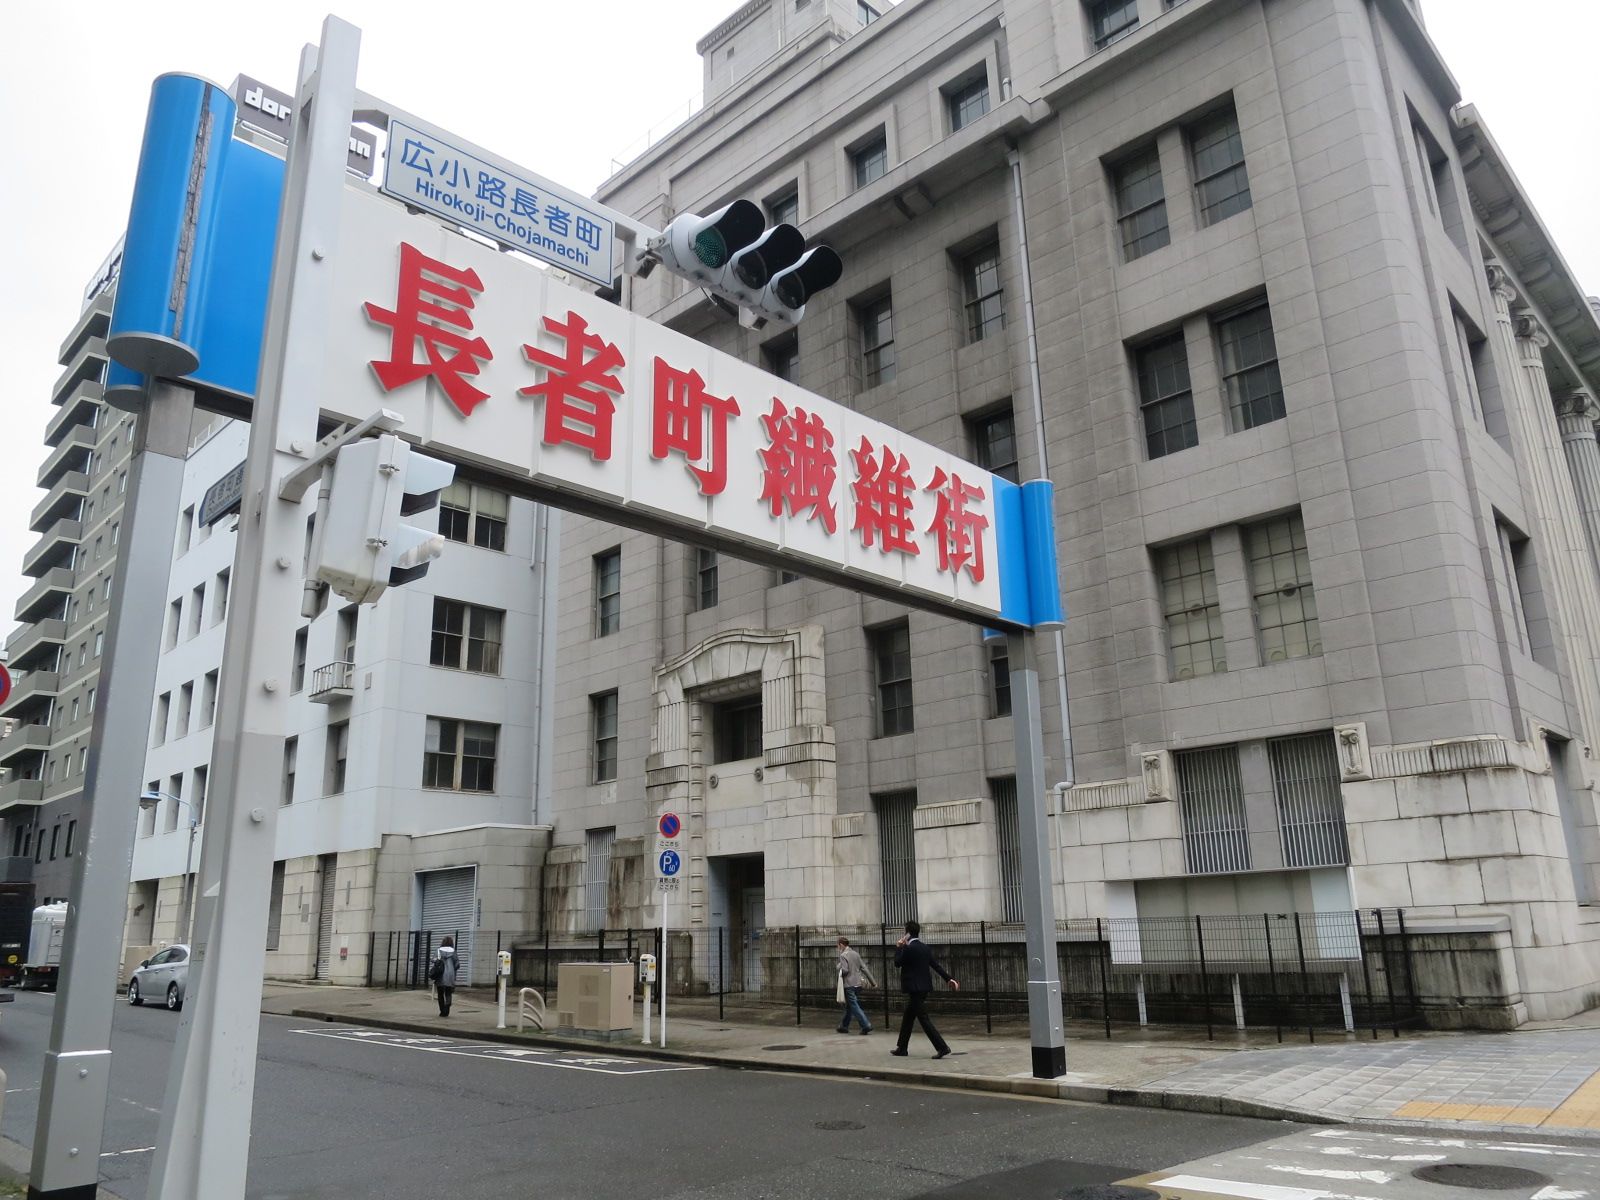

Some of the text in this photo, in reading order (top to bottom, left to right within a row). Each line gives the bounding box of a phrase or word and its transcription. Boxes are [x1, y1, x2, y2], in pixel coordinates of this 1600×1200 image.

[401, 138, 602, 251] 広小路長者町
[416, 177, 589, 266] Hirokoji-Chojamachi
[367, 244, 987, 581] 長者町繊維街
[663, 855, 672, 872] P
